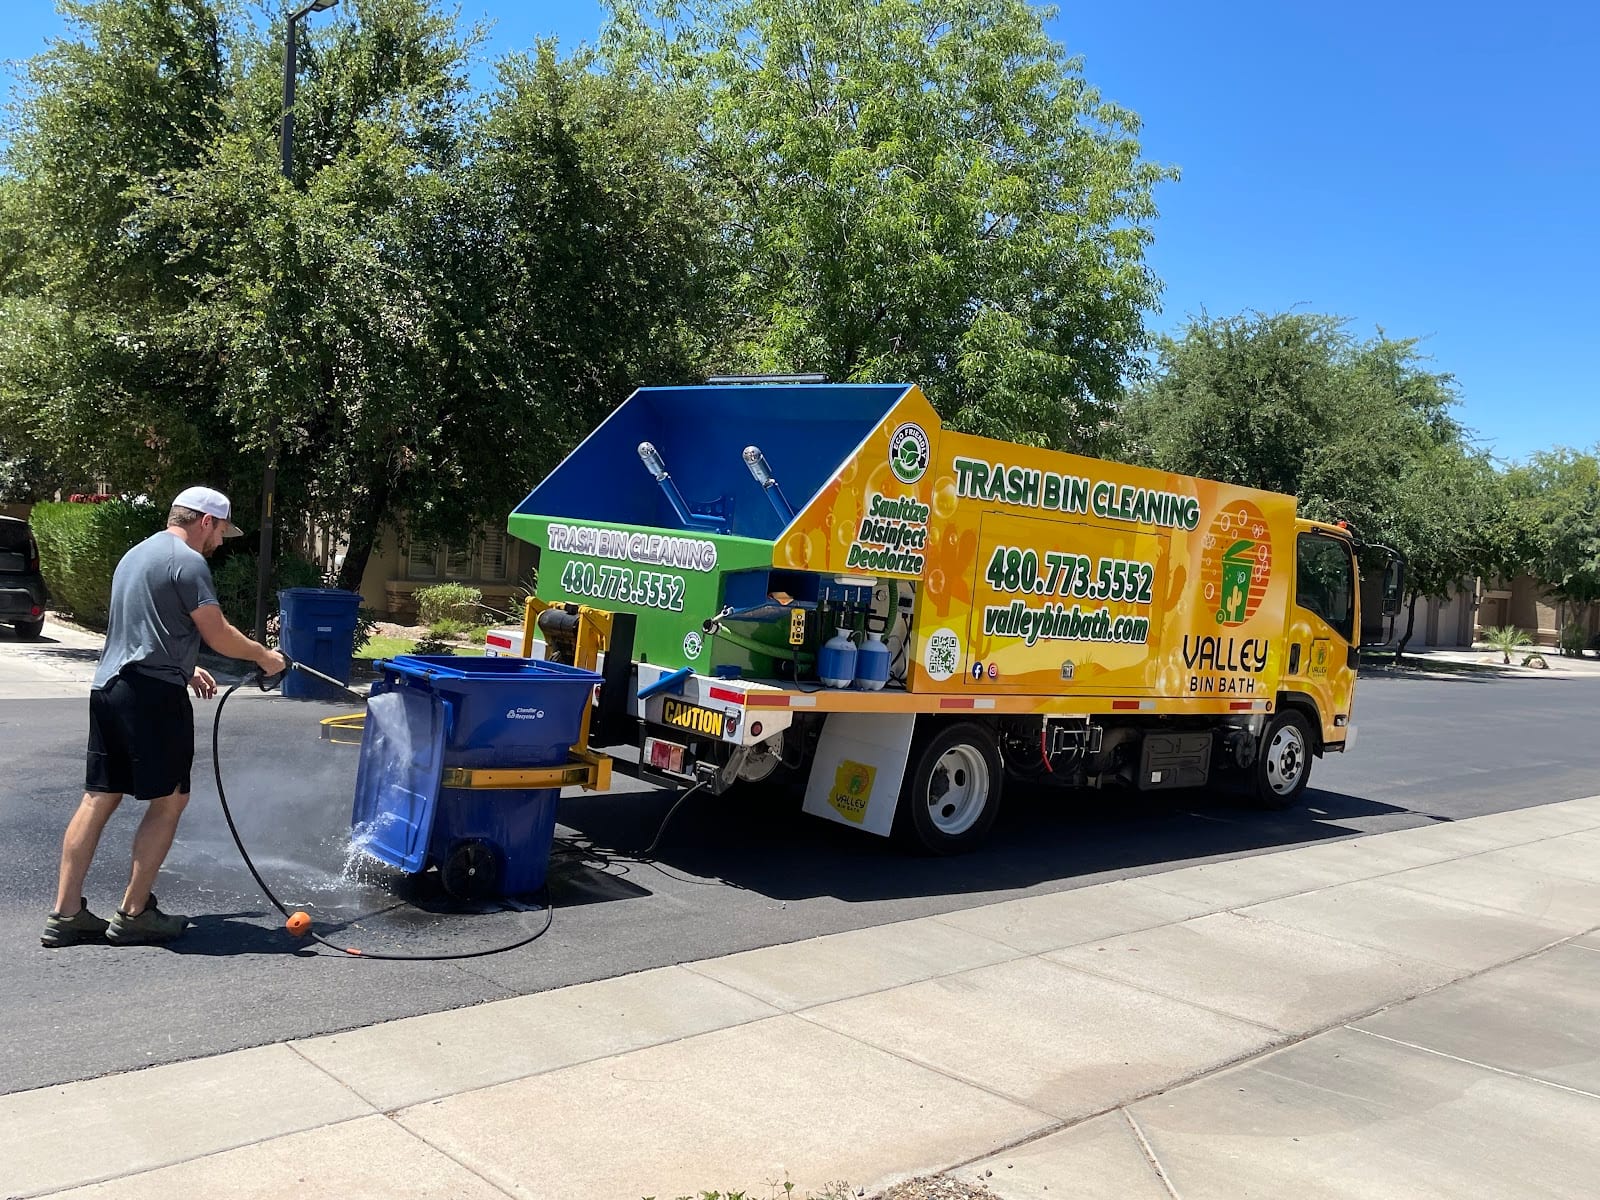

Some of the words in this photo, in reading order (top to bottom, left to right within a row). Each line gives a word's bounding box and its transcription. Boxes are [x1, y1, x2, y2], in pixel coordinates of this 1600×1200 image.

[869, 495, 930, 524] Sanitize
[953, 457, 1041, 508] TRASH
[1041, 474, 1090, 515] BIN
[1092, 482, 1200, 530] CLEANING
[549, 524, 599, 556] TRASH
[600, 530, 628, 560] BIN
[629, 534, 716, 572] CLEANING
[859, 518, 926, 550] Disinfect
[847, 544, 924, 574] Deodorize
[986, 546, 1154, 603] 480.773.5552
[561, 560, 685, 612] 480.773.5552
[984, 601, 1149, 646] valleybinbath.com
[1183, 635, 1268, 673] VALLEY
[1190, 676, 1214, 692] BIN
[1218, 677, 1255, 694] BATH
[664, 701, 723, 736] CAUTION
[836, 793, 865, 808] VALLEY
